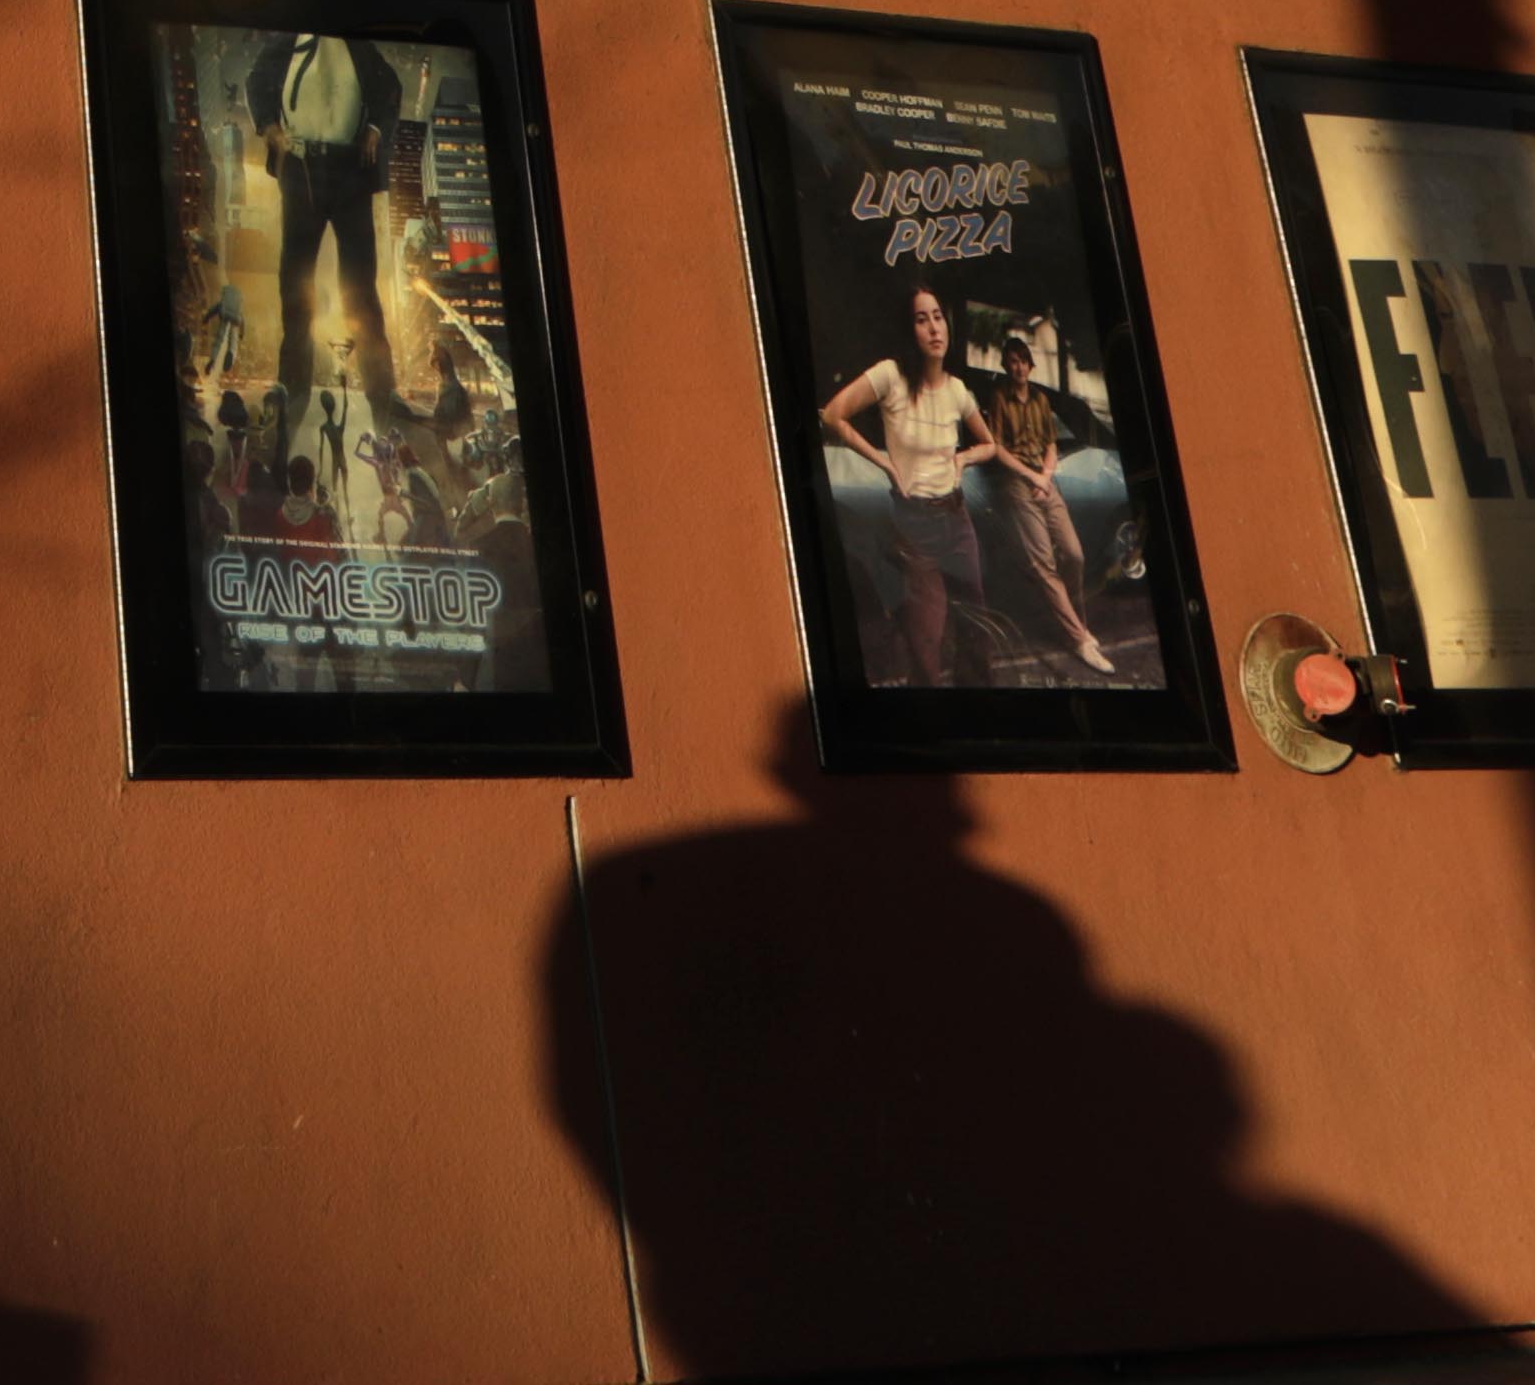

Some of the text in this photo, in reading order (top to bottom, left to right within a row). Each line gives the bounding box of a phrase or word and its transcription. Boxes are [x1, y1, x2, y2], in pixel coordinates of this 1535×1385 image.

[793, 82, 825, 95] ALANA
[860, 89, 898, 104] COOPER
[855, 102, 936, 120] BRADLEY COOPER
[852, 159, 1030, 221] LICORICE
[885, 210, 1013, 267] PIZZA
[210, 556, 502, 627] GAMESTOP
[238, 623, 487, 652] RISE OF THE PLAYERS
